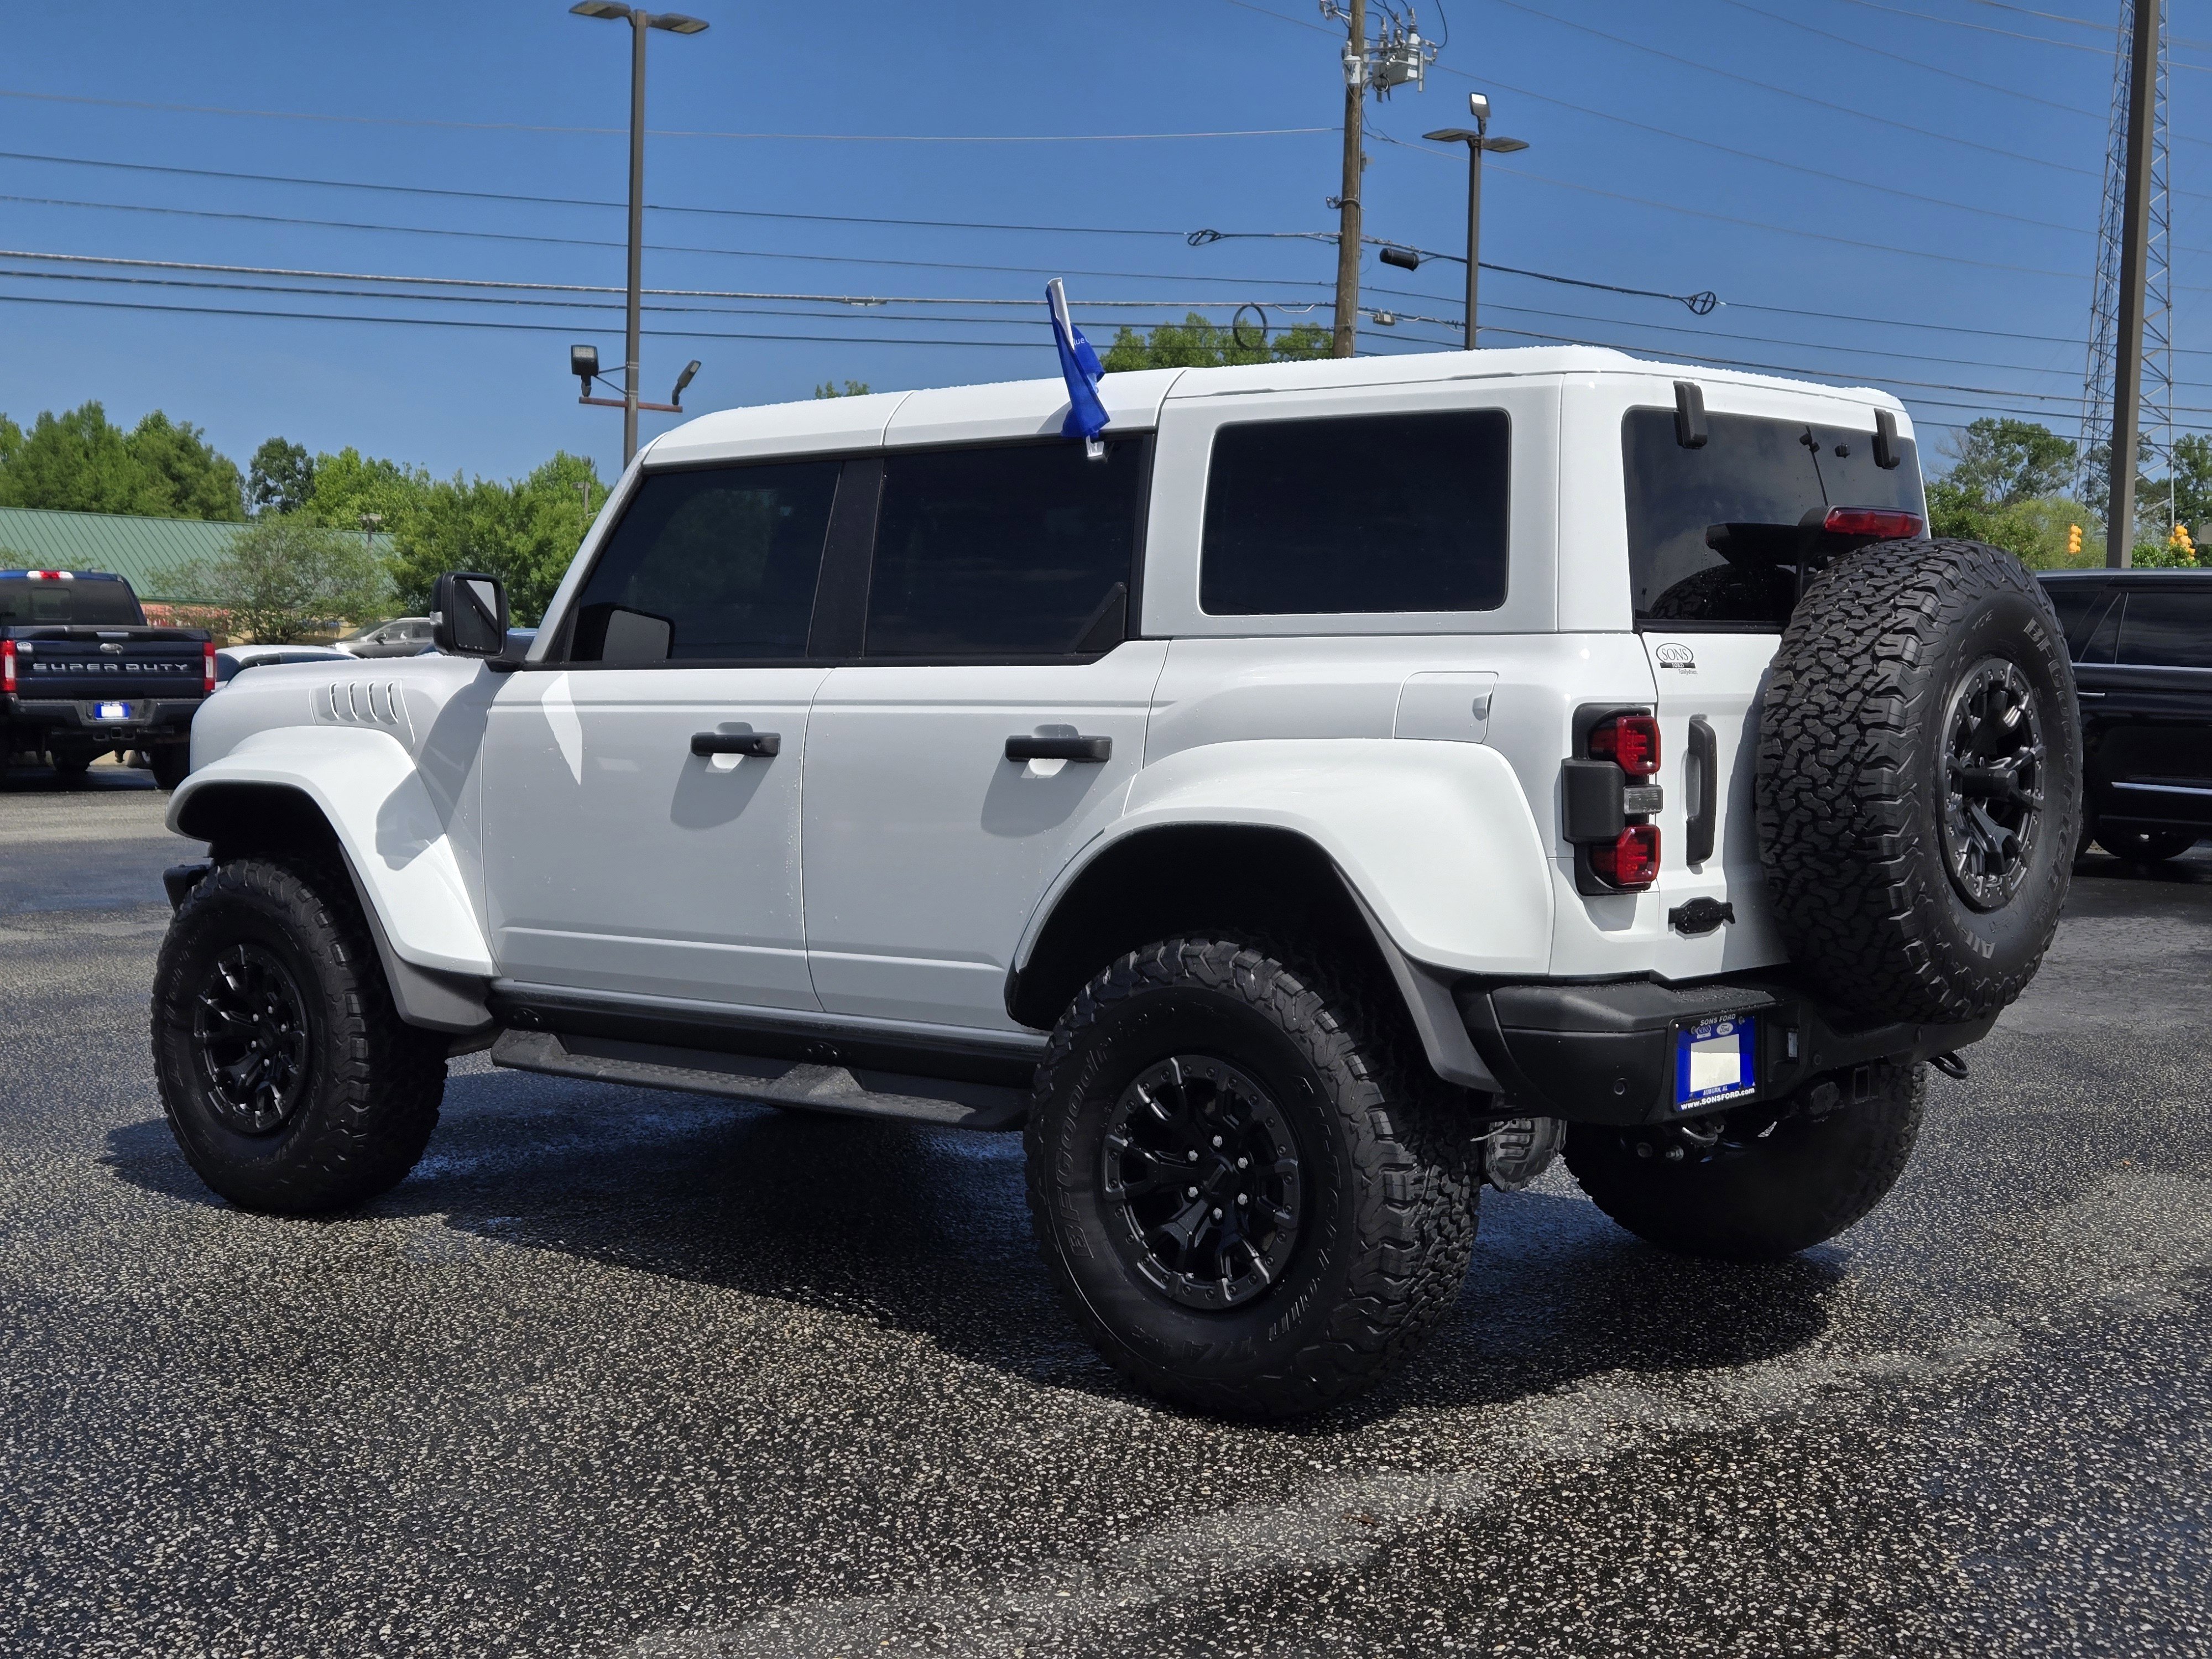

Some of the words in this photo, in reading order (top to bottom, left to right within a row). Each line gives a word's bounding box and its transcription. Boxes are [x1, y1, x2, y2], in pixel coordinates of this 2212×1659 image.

[1662, 648, 1688, 660] SONS
[1700, 1018, 1718, 1026] SONS
[1719, 1014, 1735, 1022] FORD
[1681, 1088, 1755, 1110] www.SONSFORD.com
